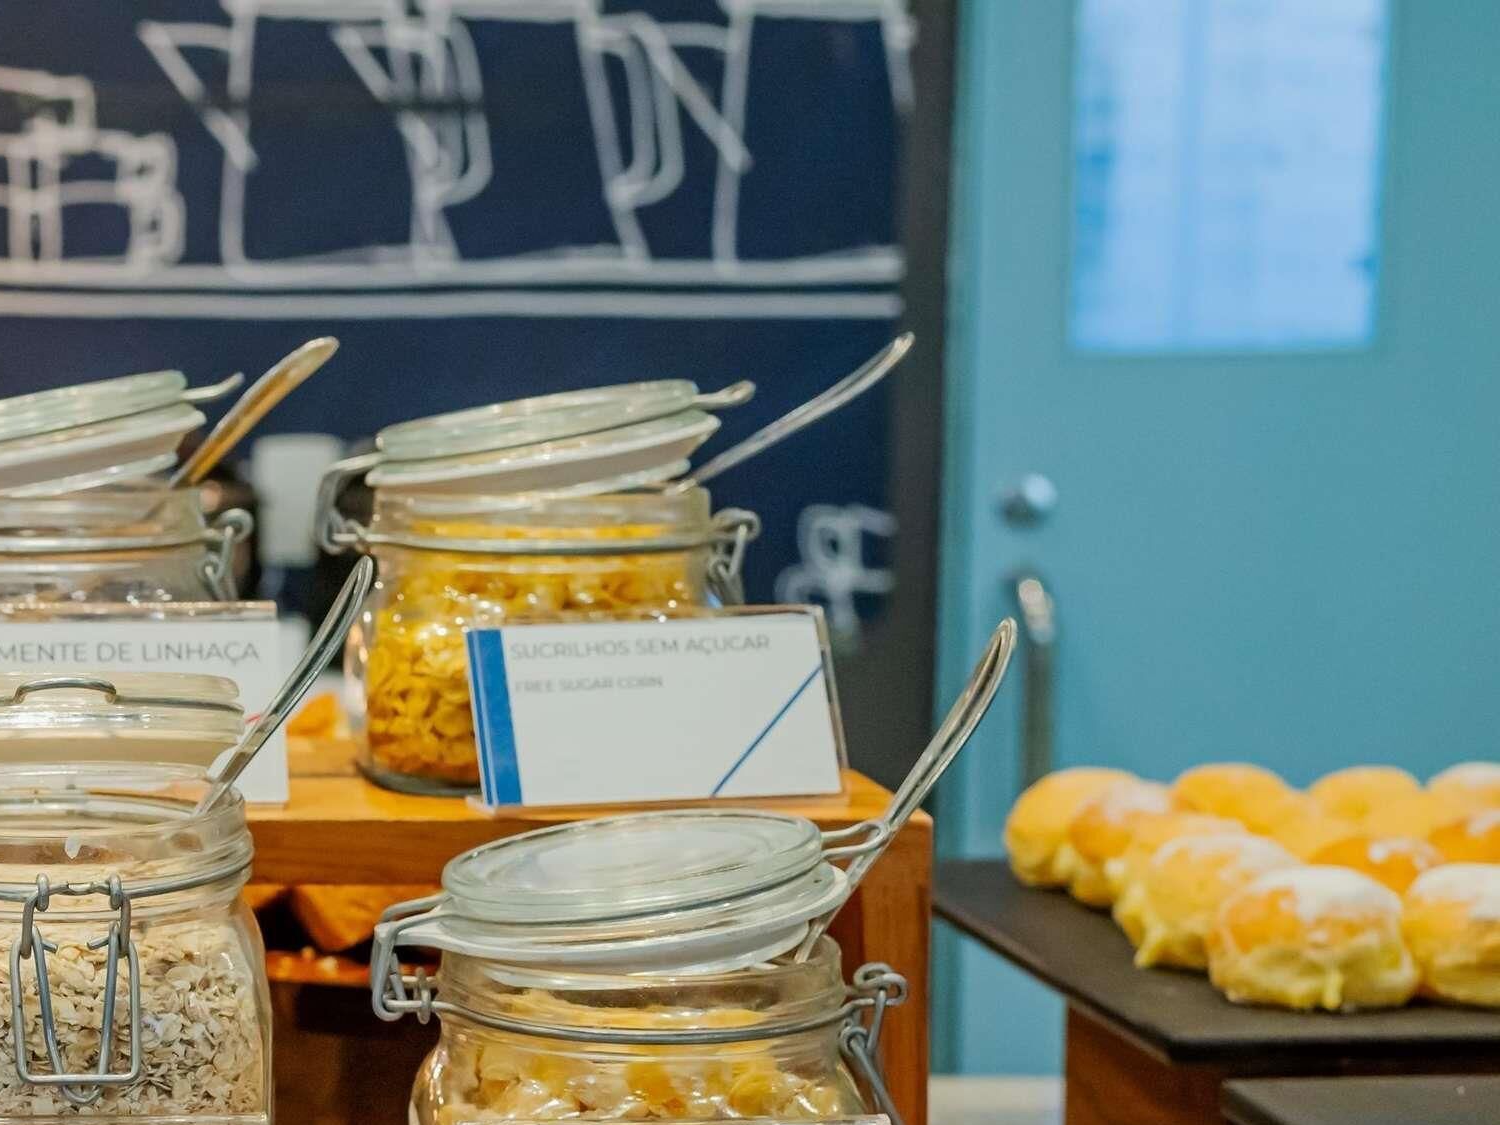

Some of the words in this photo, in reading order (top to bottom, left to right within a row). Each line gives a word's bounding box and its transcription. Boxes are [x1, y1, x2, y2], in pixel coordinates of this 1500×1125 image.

[96, 642, 133, 663] DE
[142, 642, 260, 666] LINHAÇA
[510, 638, 631, 660] SUCRILHOS
[635, 637, 680, 656] SEM
